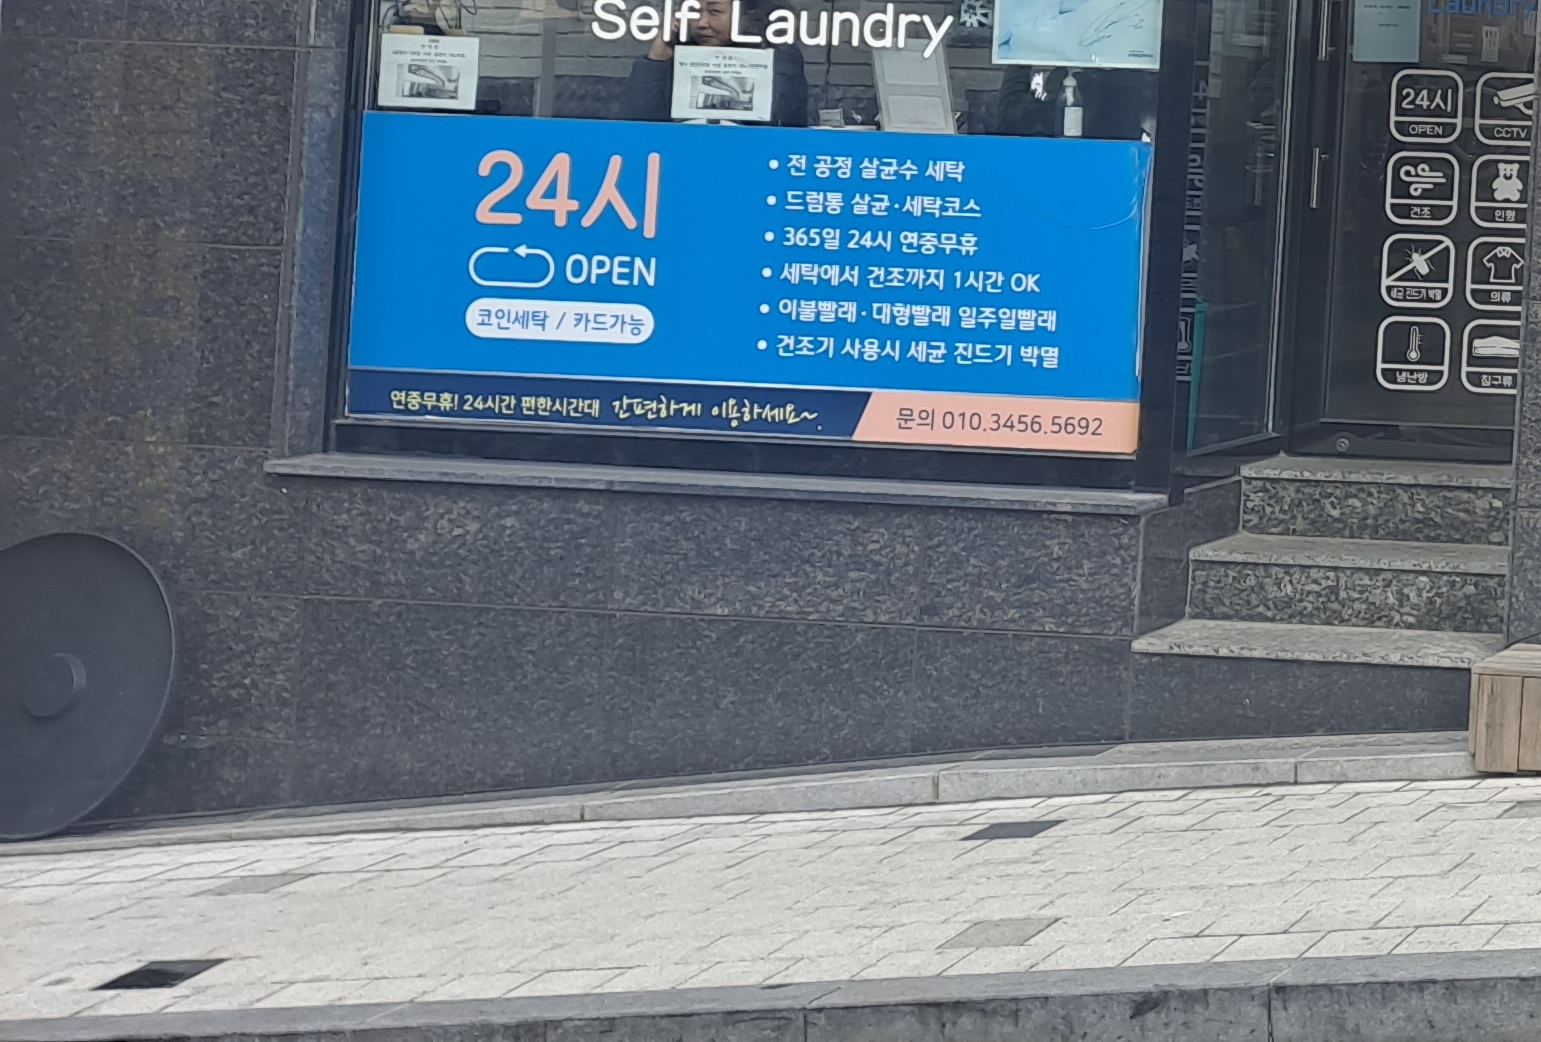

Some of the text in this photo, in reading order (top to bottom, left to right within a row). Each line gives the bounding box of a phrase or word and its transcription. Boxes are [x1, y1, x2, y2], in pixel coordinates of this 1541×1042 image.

[729, 1, 955, 59] Laundry
[1401, 87, 1453, 113] 24시
[1409, 124, 1443, 136] OPEN
[1493, 126, 1528, 139] CCTV
[787, 154, 965, 183] 전 공정 살균수 세탁
[474, 149, 661, 239] 24시
[784, 190, 844, 215] 드럼통
[1410, 205, 1432, 219] 건조
[1495, 210, 1516, 222] 인형
[783, 226, 979, 256] 365일 24시 연중무휴
[565, 255, 656, 288] OPEN
[779, 262, 1041, 293] 세탁에서 건조까지 1시간 OK
[475, 307, 548, 334] 코인세탁
[571, 310, 646, 336] 카드가능
[958, 306, 1058, 332] 일주일빨래
[775, 334, 1060, 369] 건조기 사용시 세균 진드기 박멸
[390, 389, 702, 419] 연중무휴! 24시간 편한시간대 간편하게
[896, 406, 1104, 438] 문의 010.3456.5692
